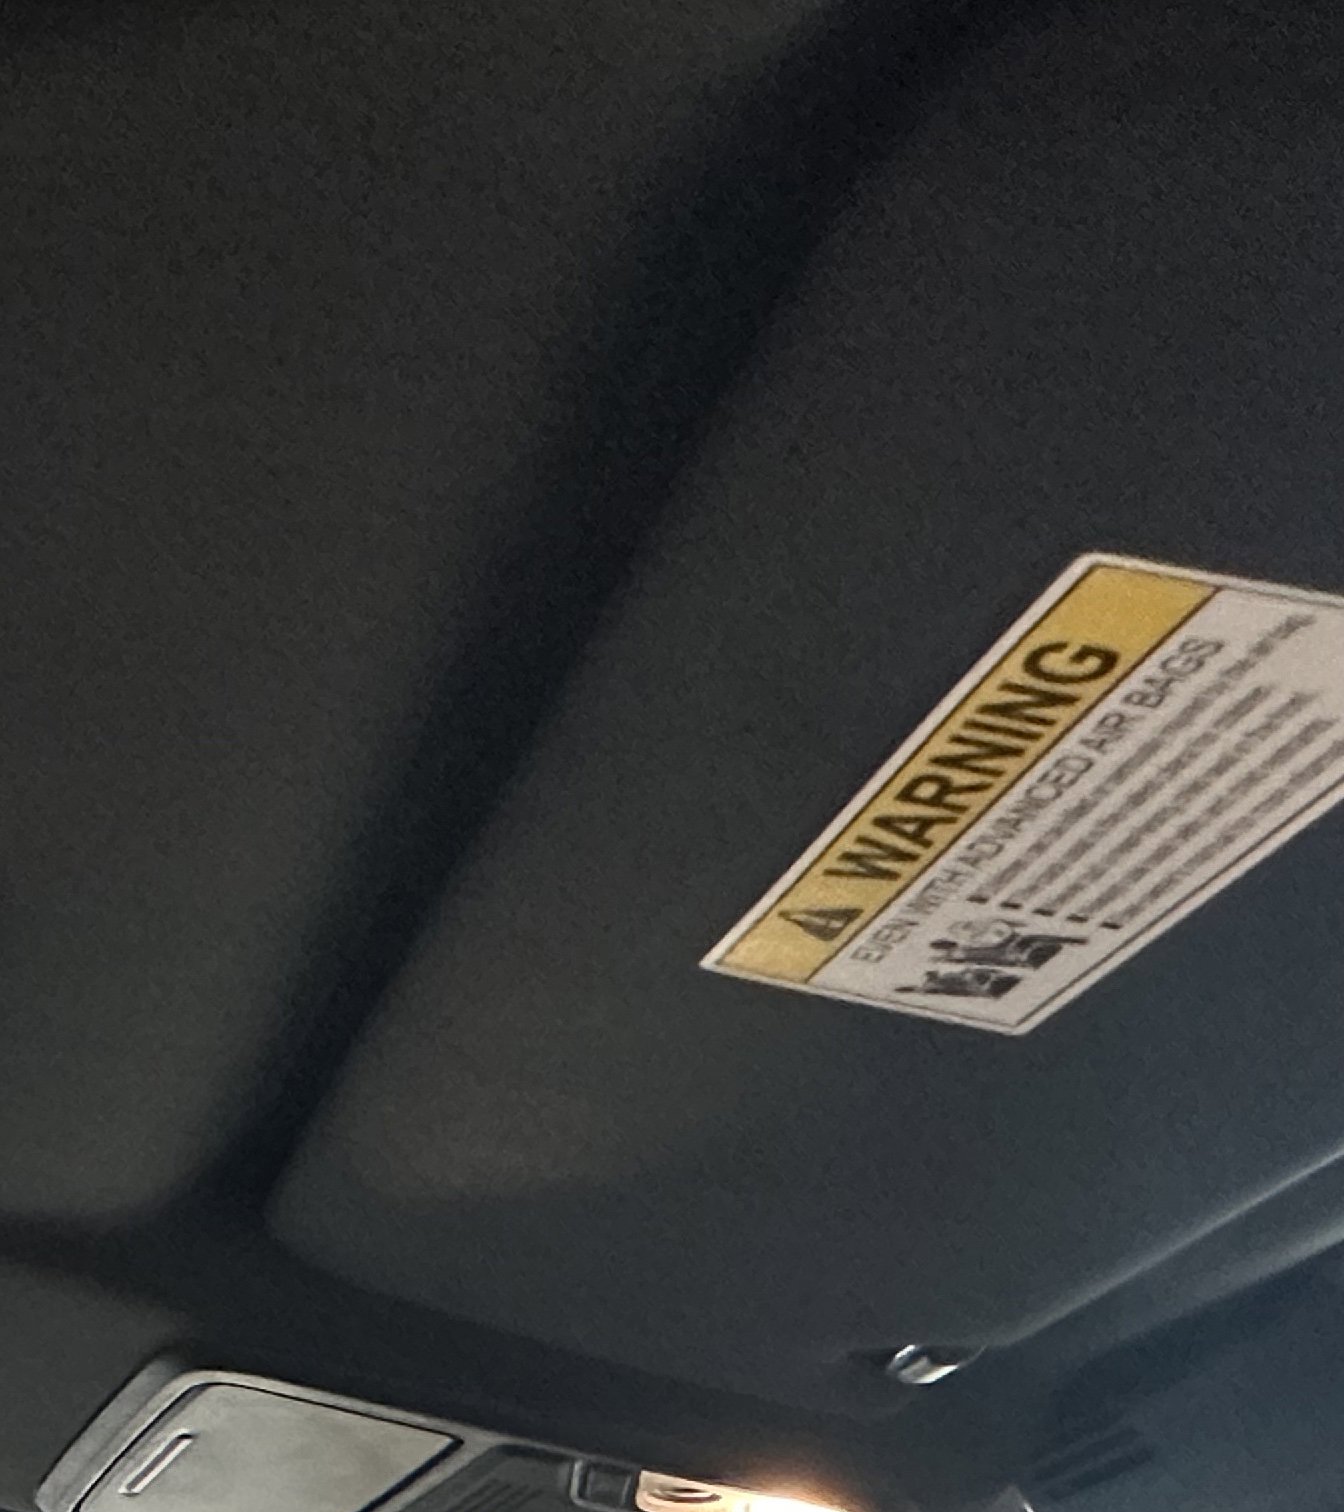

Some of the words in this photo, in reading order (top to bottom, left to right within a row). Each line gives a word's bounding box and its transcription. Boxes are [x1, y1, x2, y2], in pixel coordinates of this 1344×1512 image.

[822, 640, 1120, 884] WARNING
[850, 918, 920, 964] EVEN
[899, 868, 971, 915] WITH
[957, 755, 1095, 868] ADVANCED
[1078, 711, 1146, 756] AIR
[1121, 635, 1226, 709] BAGS
